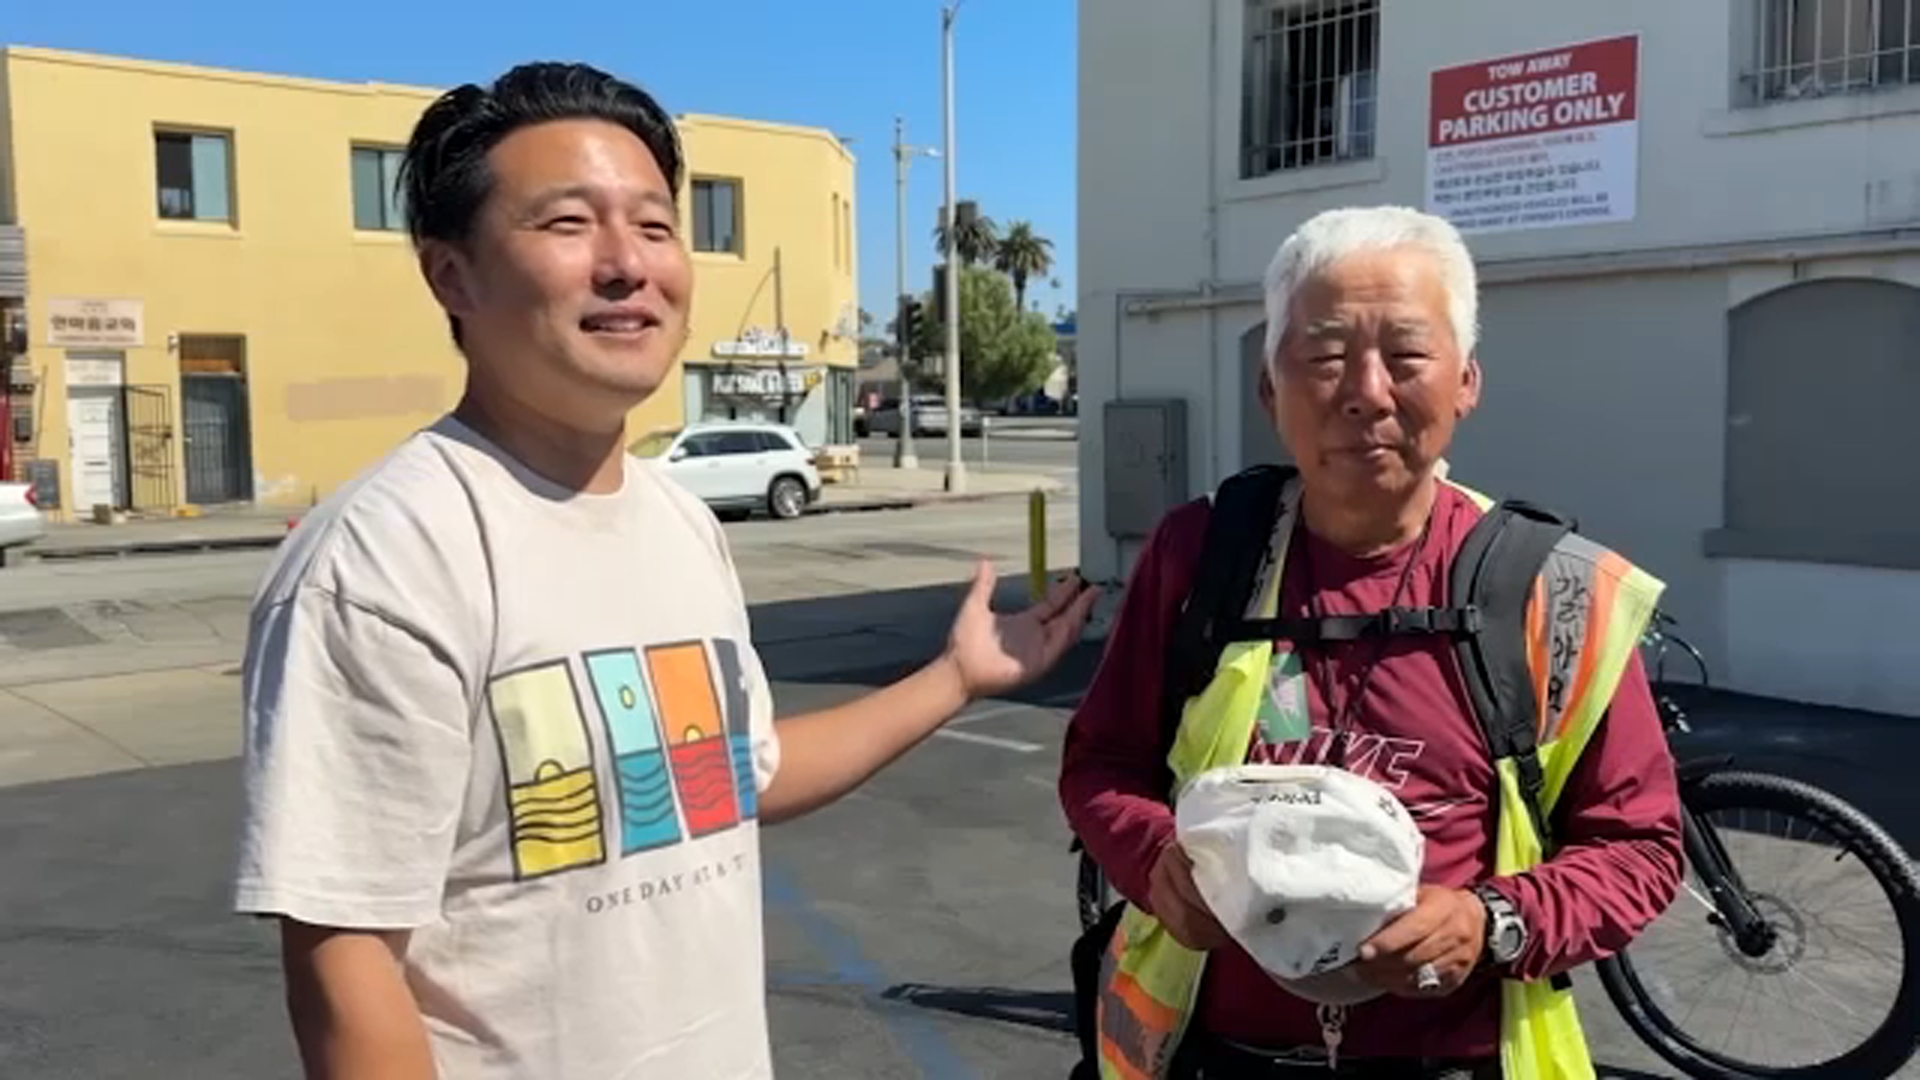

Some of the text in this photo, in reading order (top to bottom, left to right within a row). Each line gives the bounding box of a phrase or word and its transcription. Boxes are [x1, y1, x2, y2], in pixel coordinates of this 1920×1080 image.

[1488, 53, 1572, 81] TOW AWAY
[1463, 71, 1598, 112] CUSTOMER
[1439, 92, 1625, 141] PARKING ONLY
[586, 887, 633, 913] ONE
[639, 873, 684, 900] DAY
